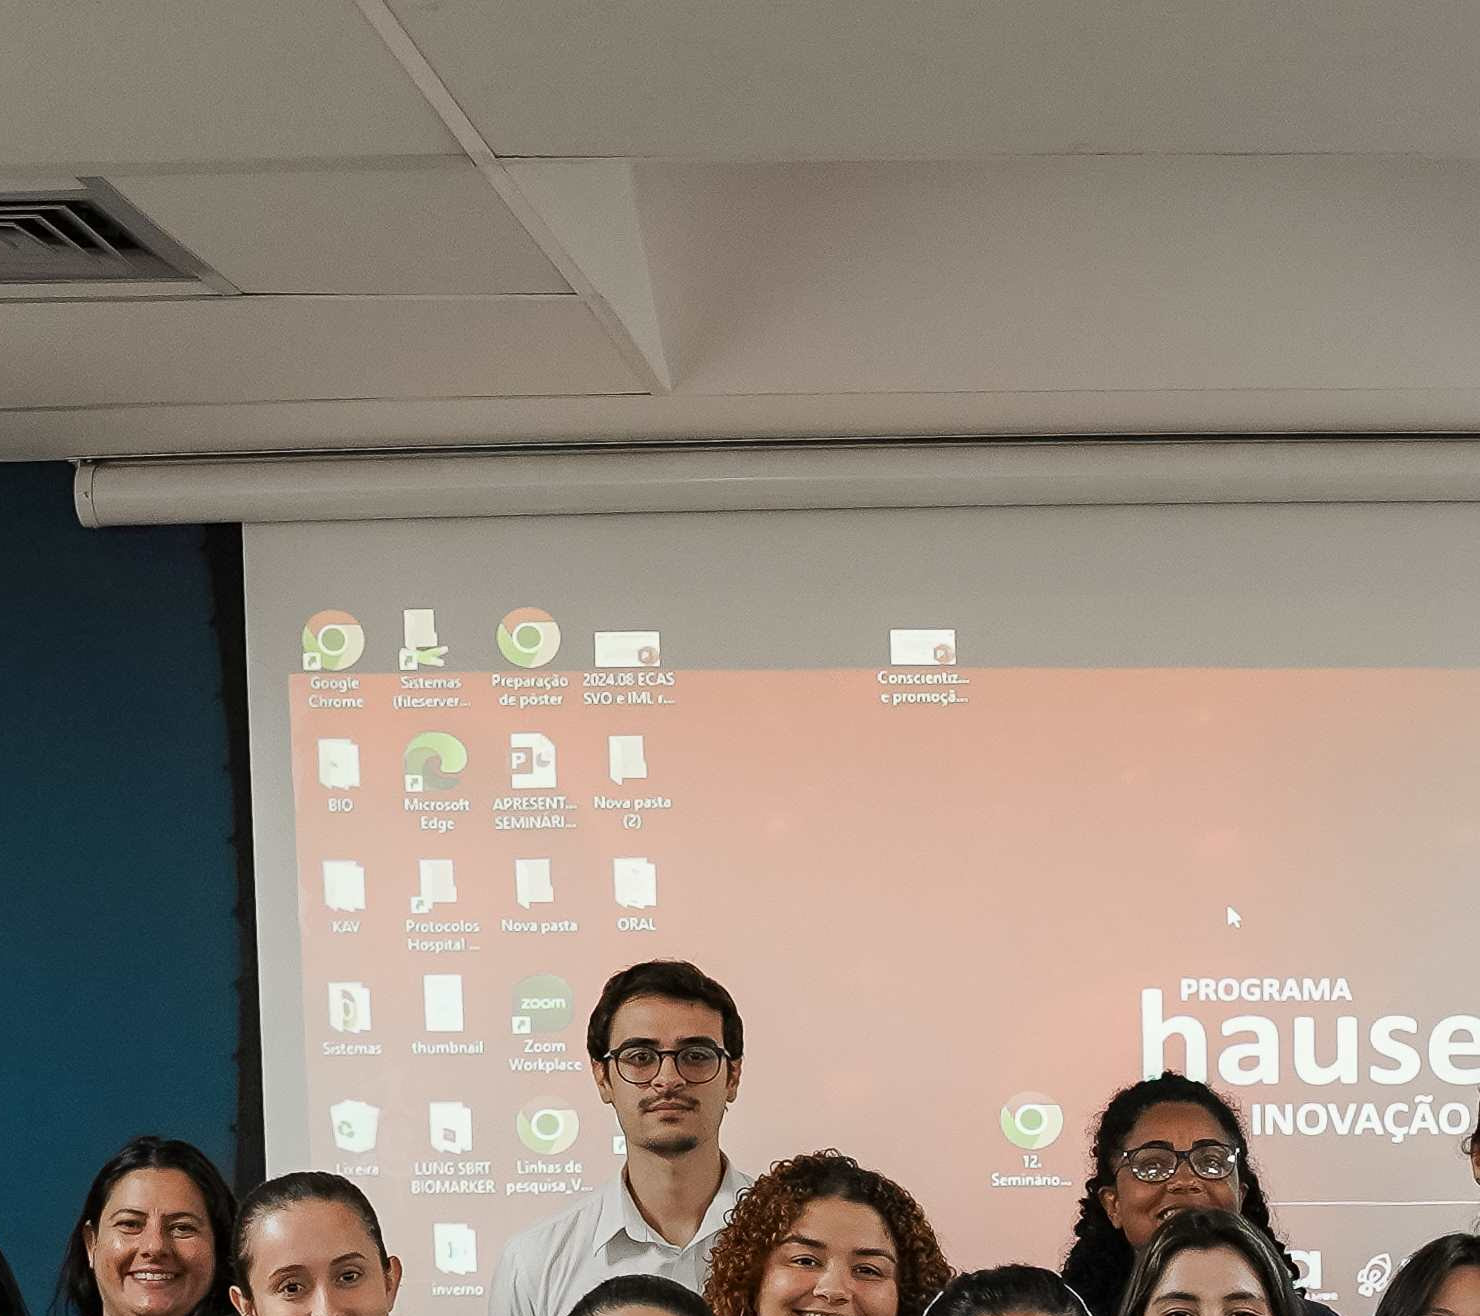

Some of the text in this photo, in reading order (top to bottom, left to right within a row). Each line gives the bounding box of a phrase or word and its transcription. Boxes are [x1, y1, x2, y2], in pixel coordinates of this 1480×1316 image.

[310, 677, 360, 691] Google
[400, 676, 462, 690] Sistemas
[491, 675, 569, 691] Preparação
[308, 697, 364, 709] Chrome
[499, 693, 517, 706] de
[615, 695, 625, 705] e
[327, 798, 354, 813] BIO
[404, 798, 470, 812] Microsoft
[593, 796, 672, 813] Nova pasta
[420, 816, 455, 833] Edge
[623, 814, 643, 831] (2)
[406, 918, 480, 934] Protocolos
[501, 918, 578, 935] Nova pasta
[616, 917, 656, 932] ORAL
[407, 937, 467, 953] Hospital
[1179, 977, 1353, 1002] PROGRAMA
[520, 995, 566, 1010] zoom
[322, 1041, 382, 1056] Sistemas
[411, 1040, 484, 1055] thumbnail
[523, 1040, 566, 1054] Zoom
[509, 1057, 583, 1074] Workplace
[1250, 1095, 1473, 1144] INOVAÇÃO
[414, 1162, 491, 1176] LUNG SBRT
[516, 1160, 583, 1175] Linhas de
[410, 1180, 496, 1195] BIOMARKER
[431, 1283, 484, 1296] inverno
